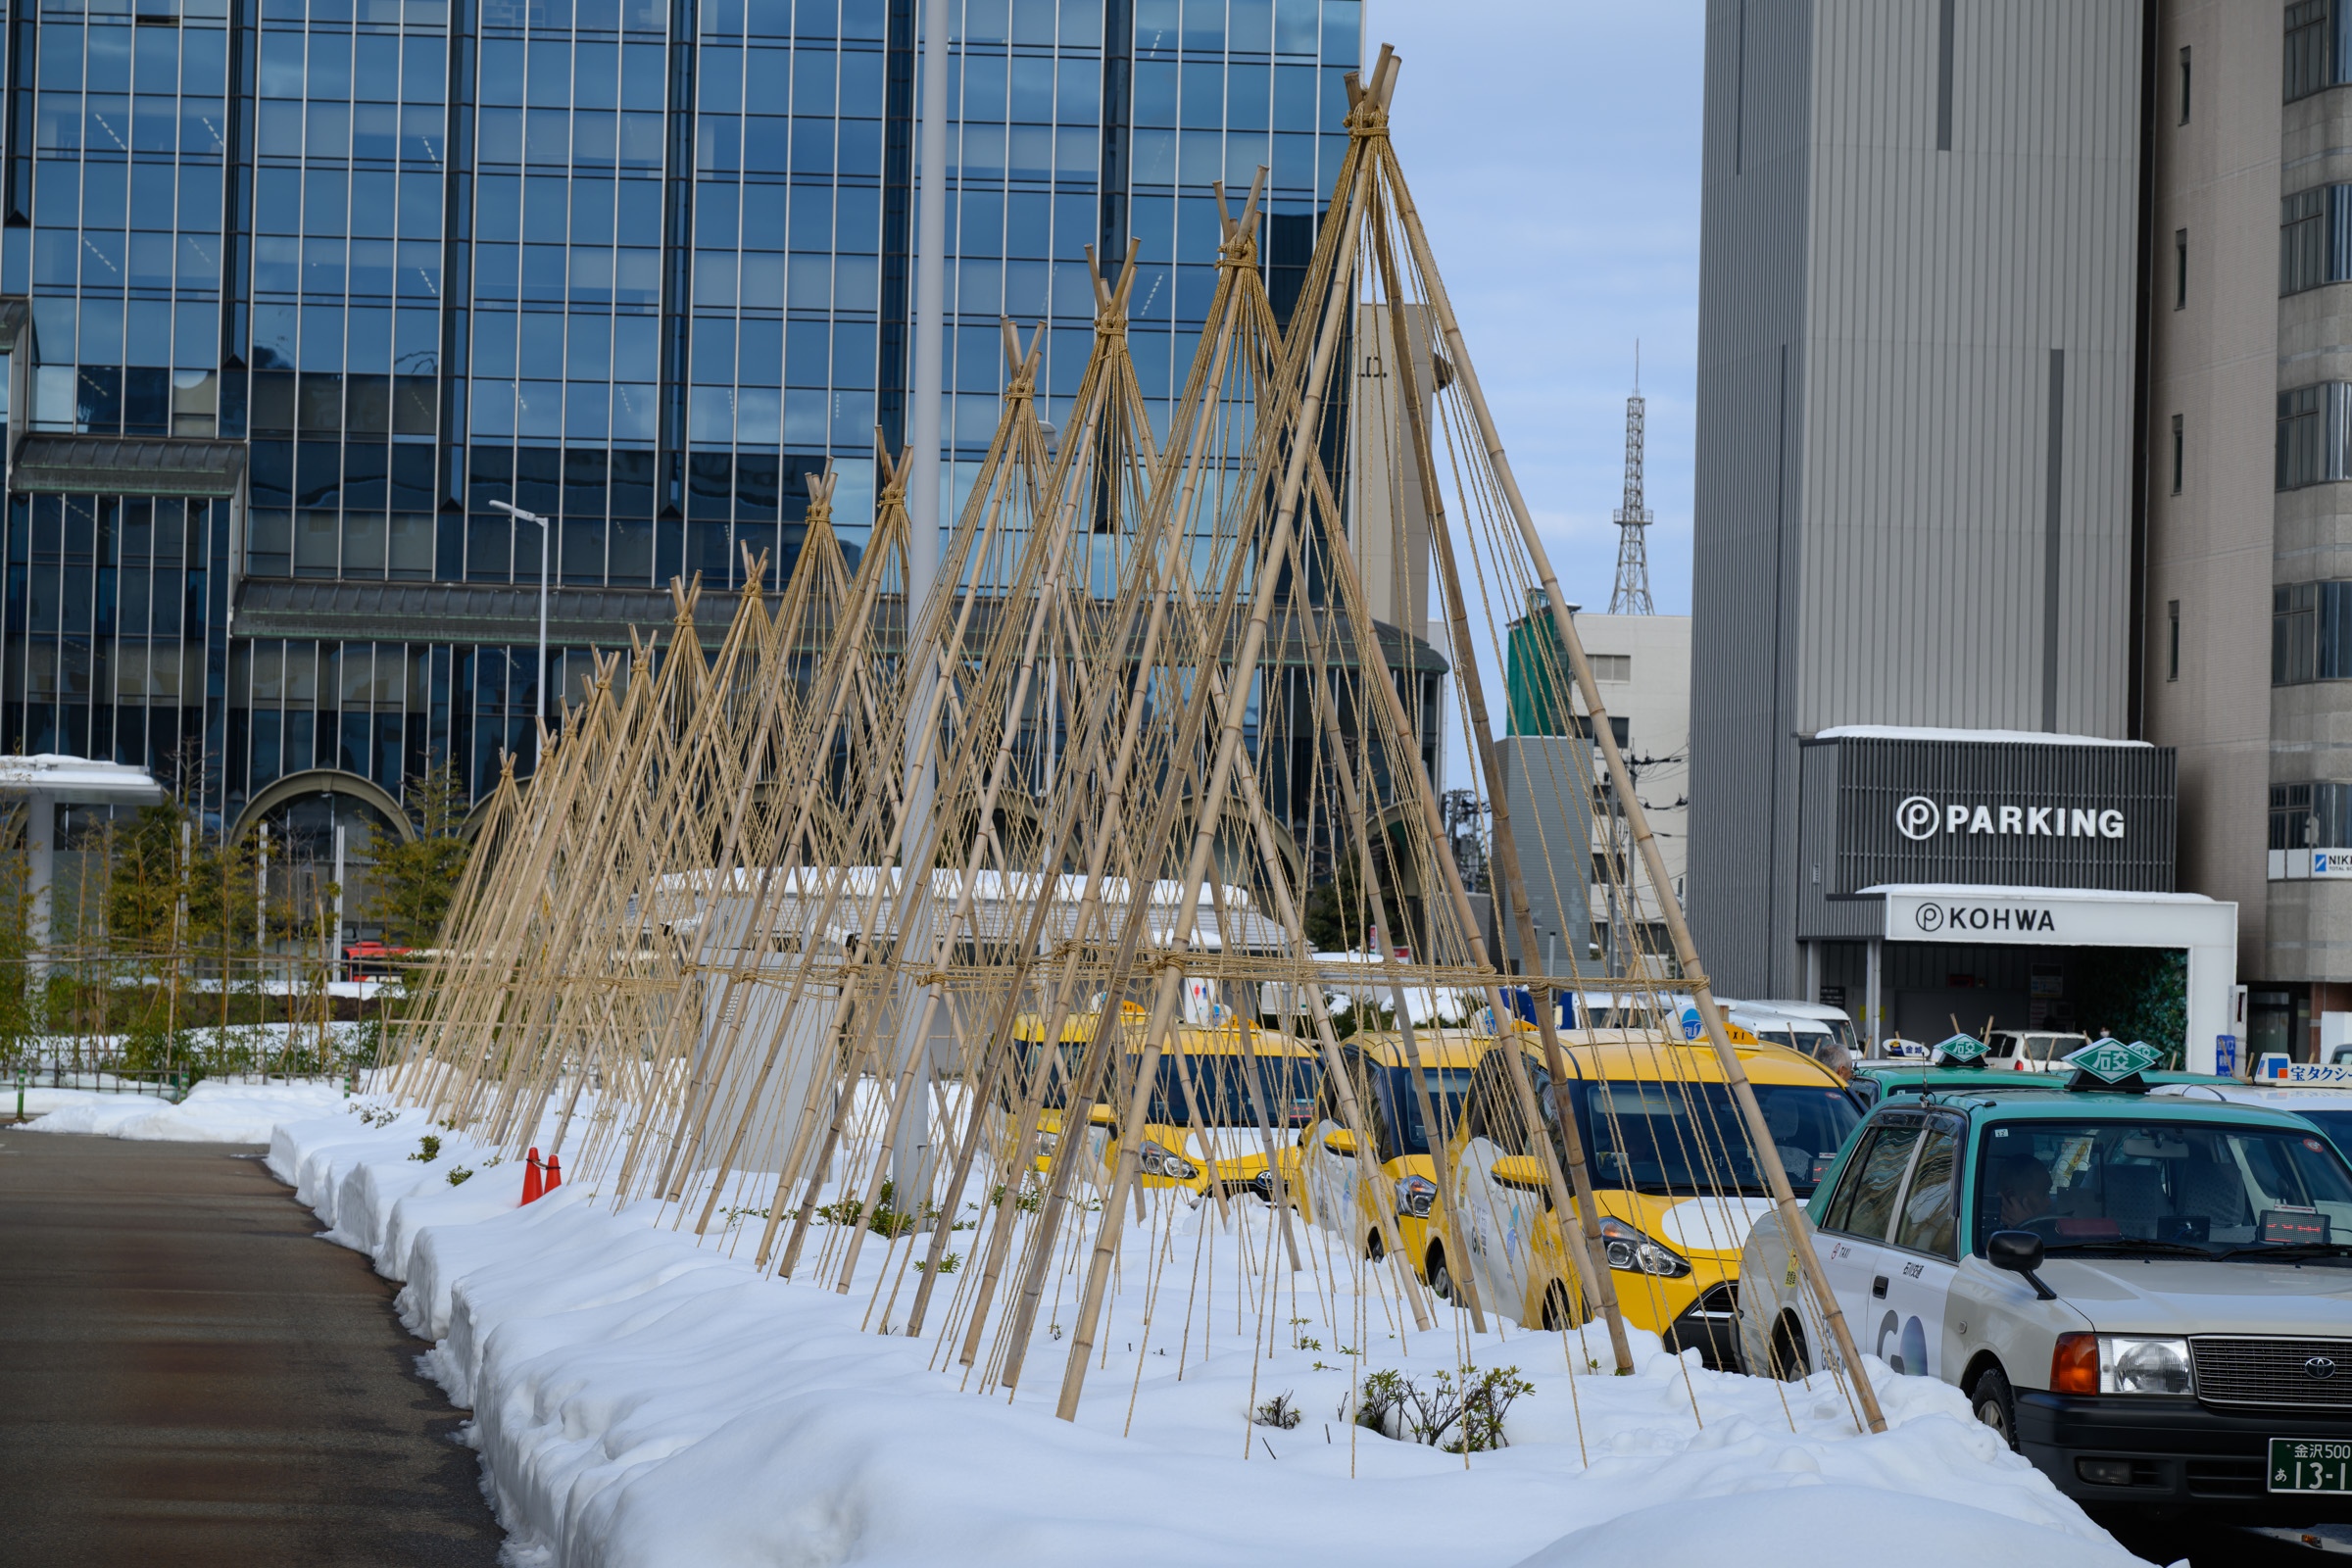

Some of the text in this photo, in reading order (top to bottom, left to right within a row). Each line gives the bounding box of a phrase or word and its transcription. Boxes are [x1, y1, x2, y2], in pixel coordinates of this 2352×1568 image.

[1947, 805, 2125, 839] PARKING
[2328, 855, 2352, 865] NIK
[1949, 907, 2055, 932] KOHWA
[2275, 1467, 2287, 1483] あ
